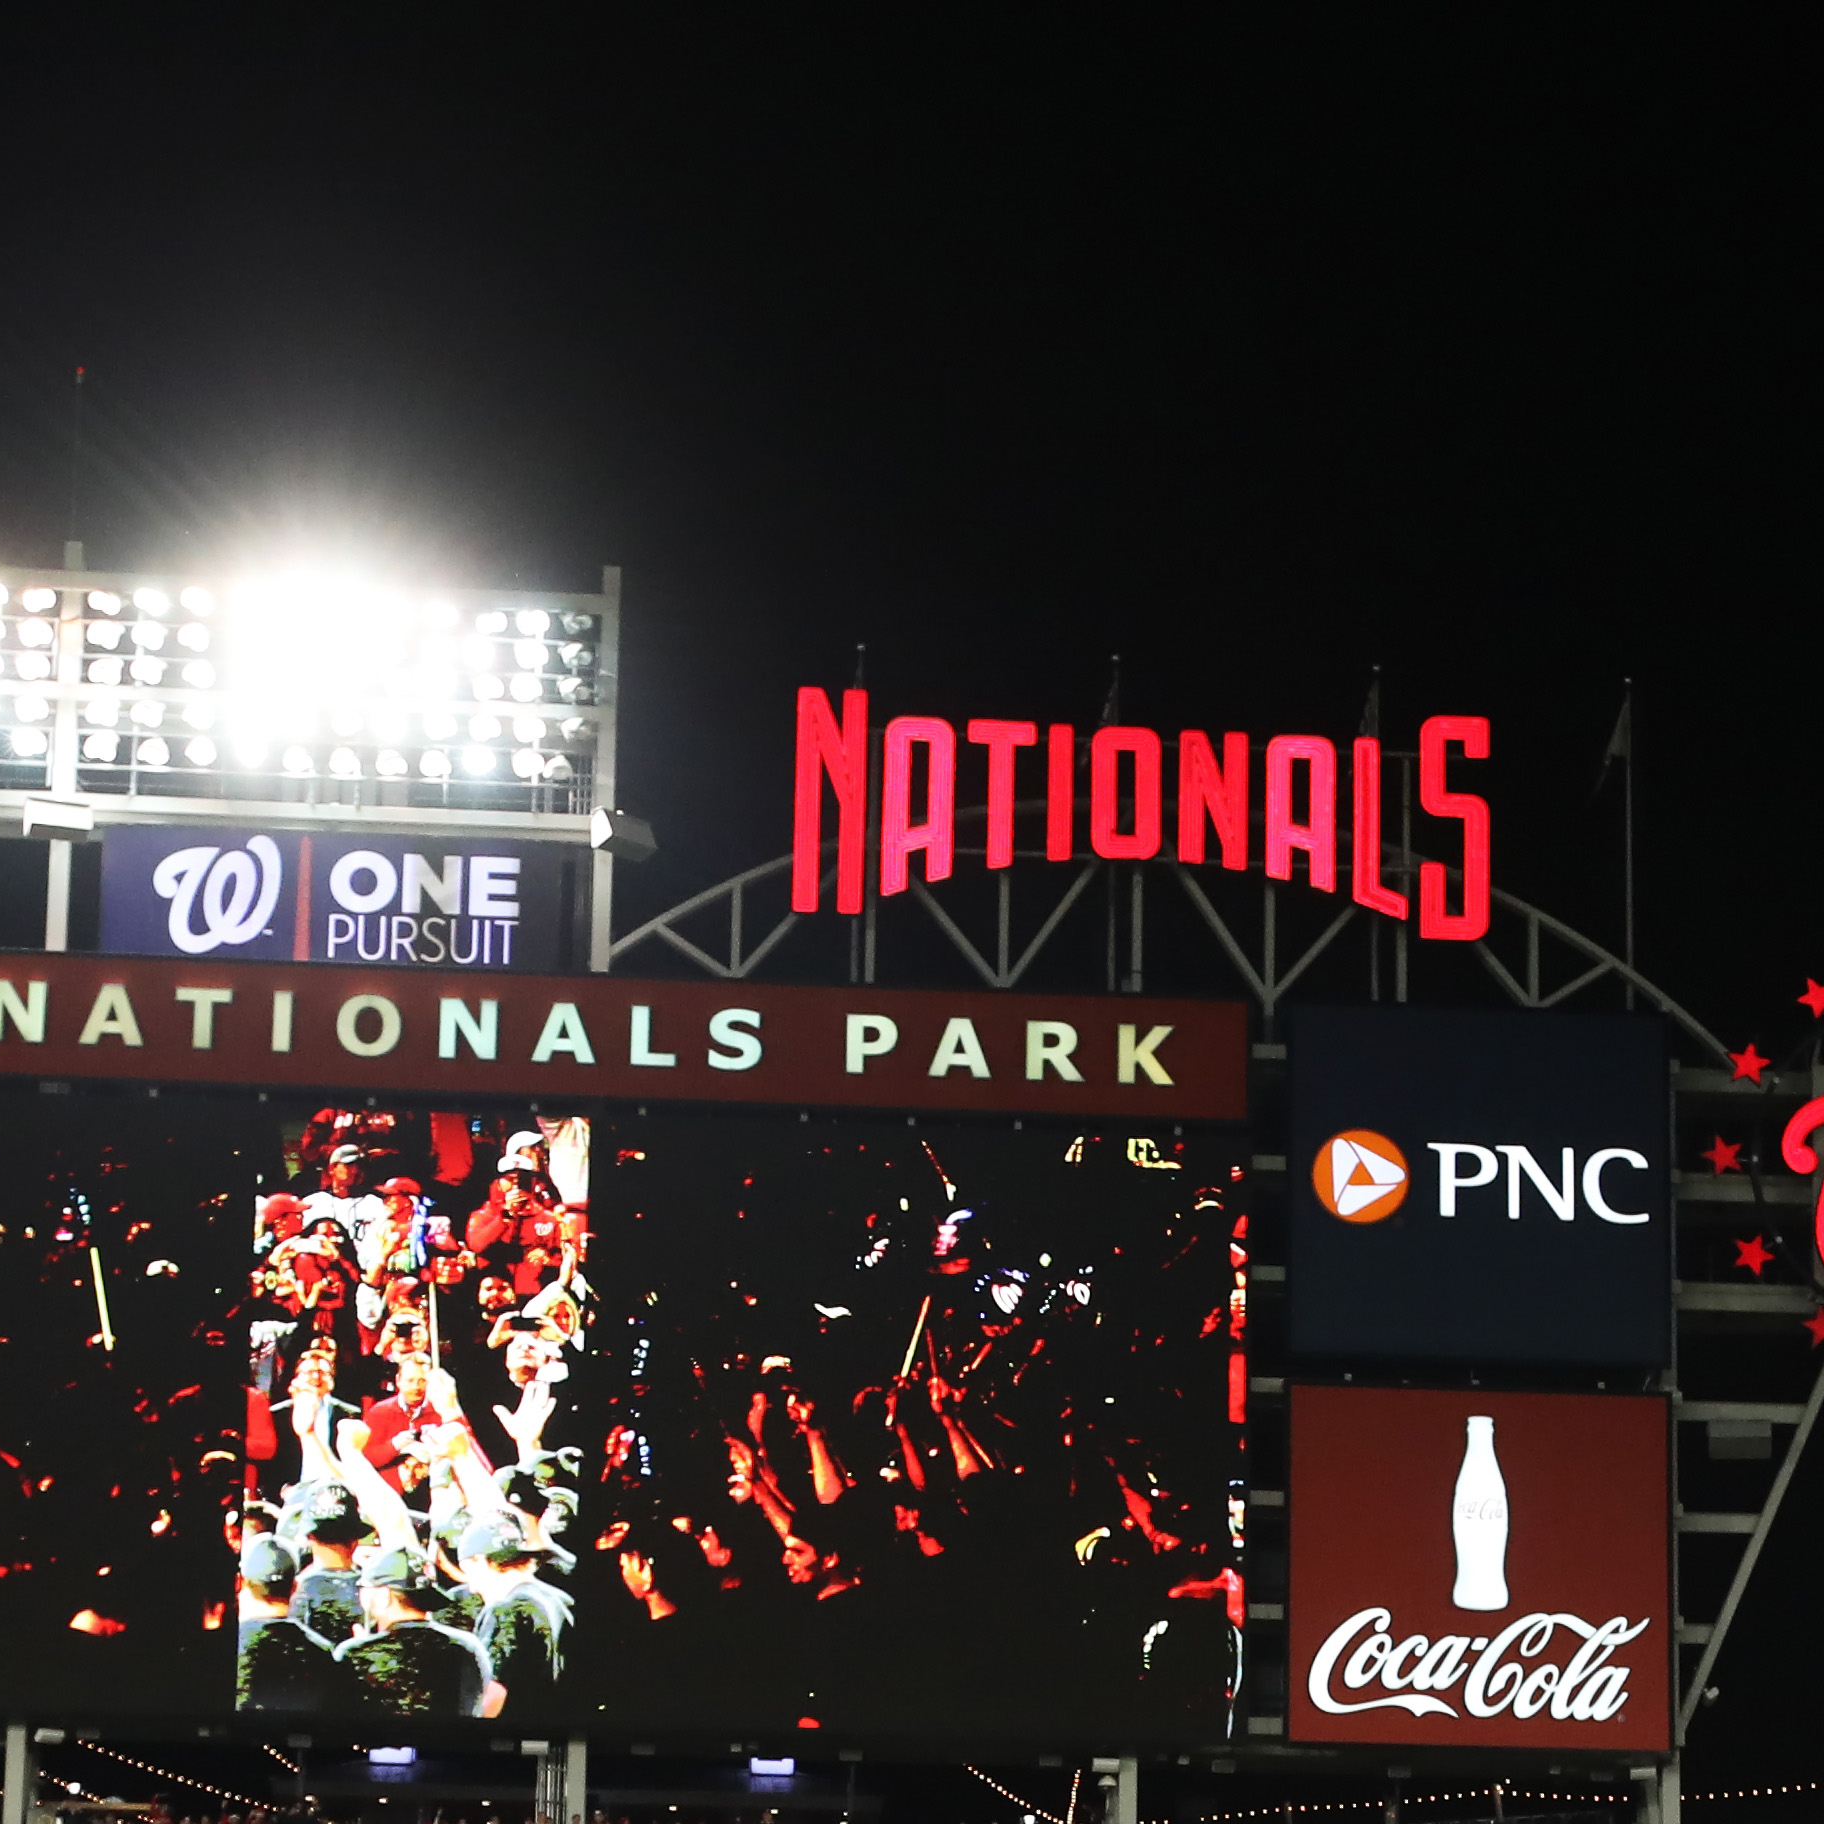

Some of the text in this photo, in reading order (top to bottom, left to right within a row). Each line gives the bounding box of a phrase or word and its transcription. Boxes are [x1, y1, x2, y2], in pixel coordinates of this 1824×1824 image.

[792, 686, 1491, 941] NATIONALS
[328, 850, 520, 917] ONE
[327, 914, 519, 964] PURSUIT
[845, 1012, 1177, 1087] PARK
[1427, 1142, 1650, 1224] PNC
[1308, 1607, 1651, 1721] Coca-Cola
